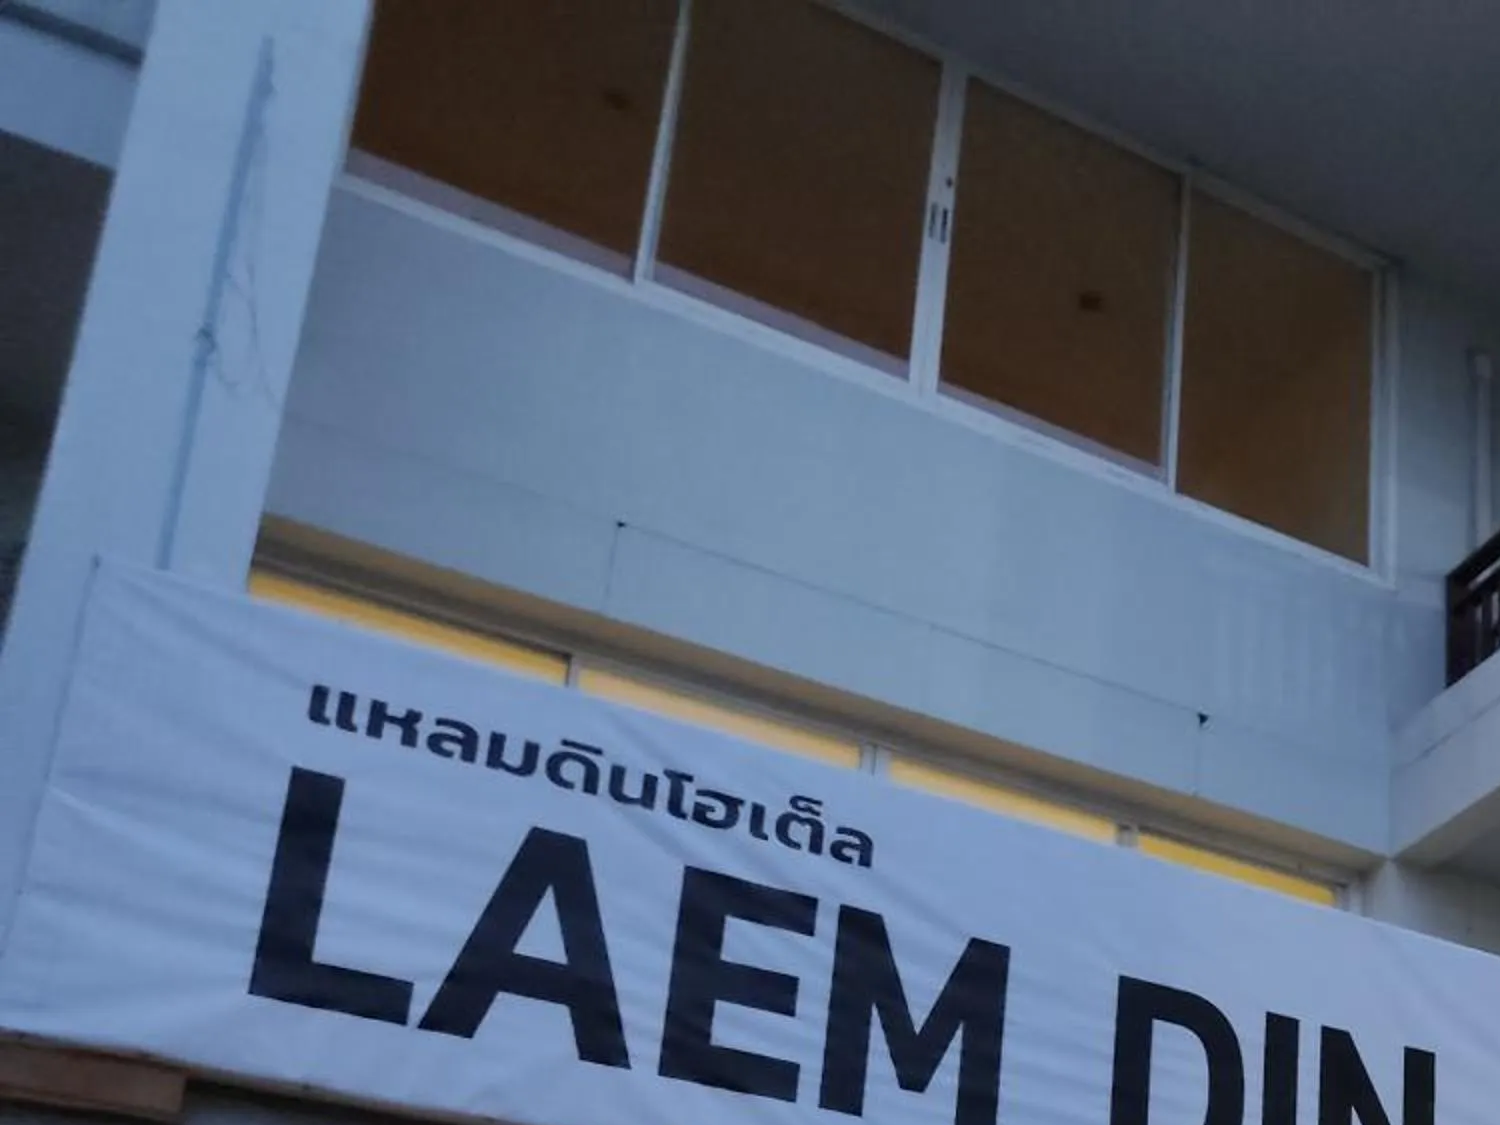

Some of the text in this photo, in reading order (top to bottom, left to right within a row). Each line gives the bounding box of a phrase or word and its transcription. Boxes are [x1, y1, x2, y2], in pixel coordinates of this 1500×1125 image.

[307, 684, 874, 869] แหลมดินโฮเต็ล
